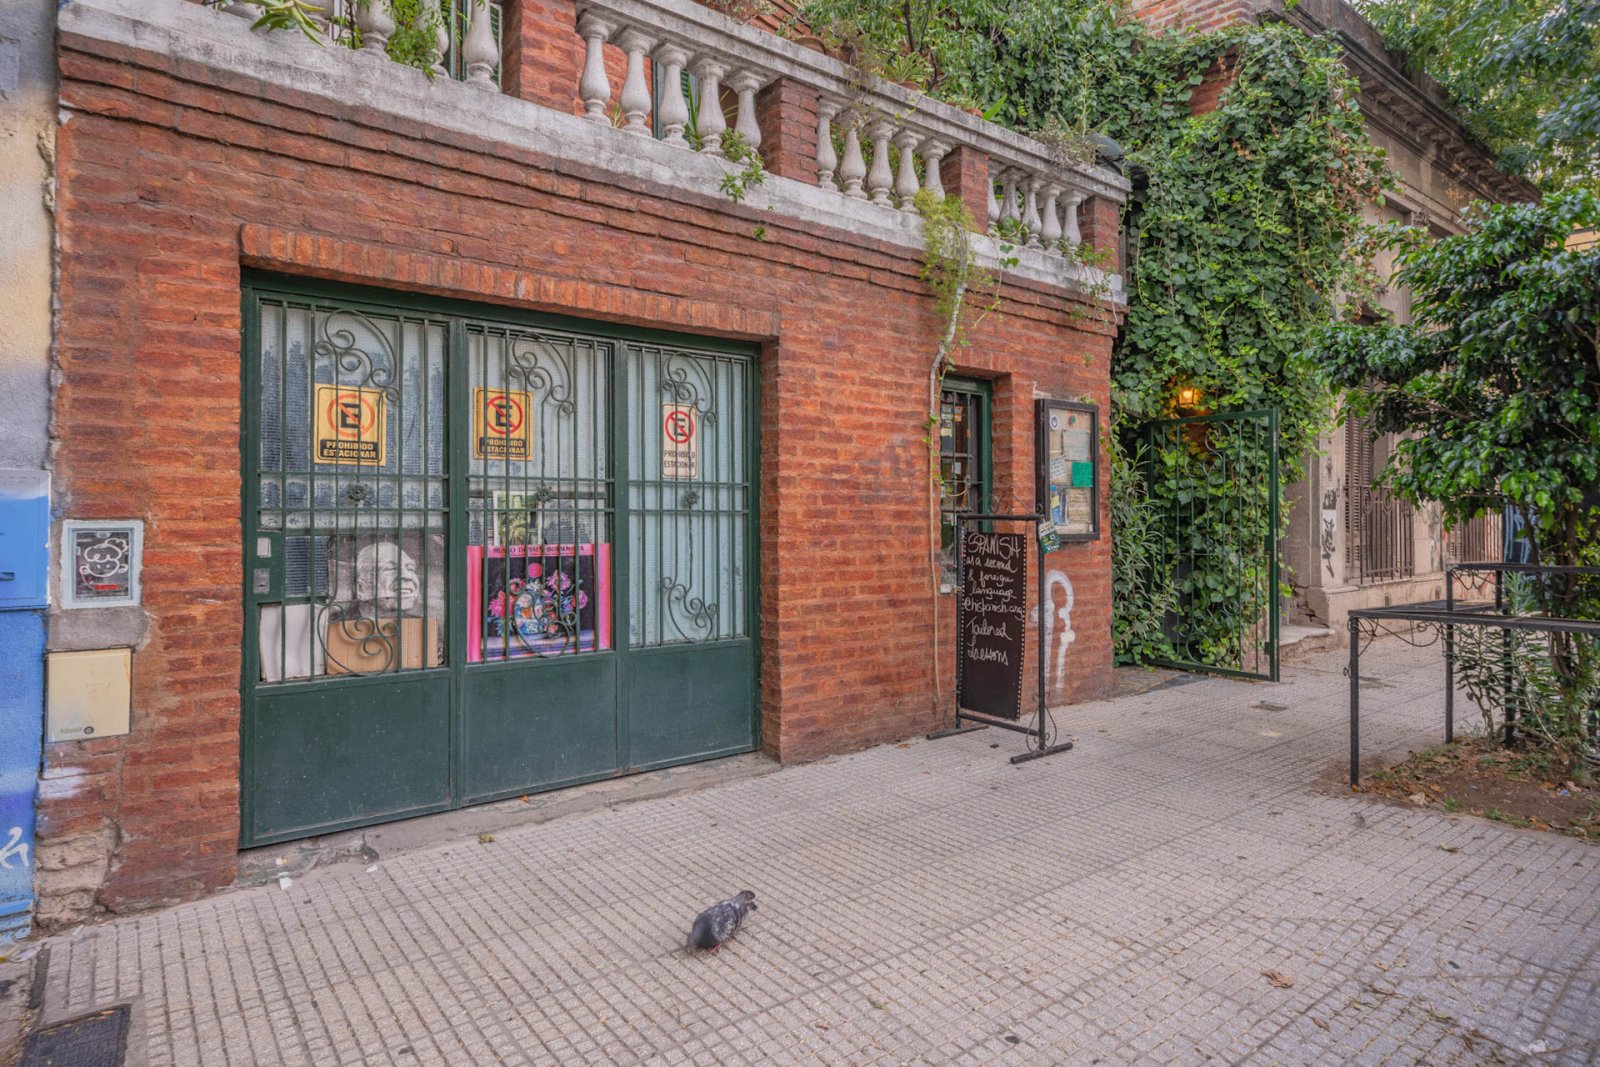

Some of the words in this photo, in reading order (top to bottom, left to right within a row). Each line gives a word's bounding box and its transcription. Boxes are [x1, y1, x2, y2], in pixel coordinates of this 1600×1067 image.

[326, 441, 374, 450] PROHIBDO
[984, 558, 1018, 573] second
[980, 571, 1014, 588] foreign
[969, 581, 1017, 602] language
[966, 616, 1013, 640] Tailored
[967, 635, 1009, 667] Lessons
